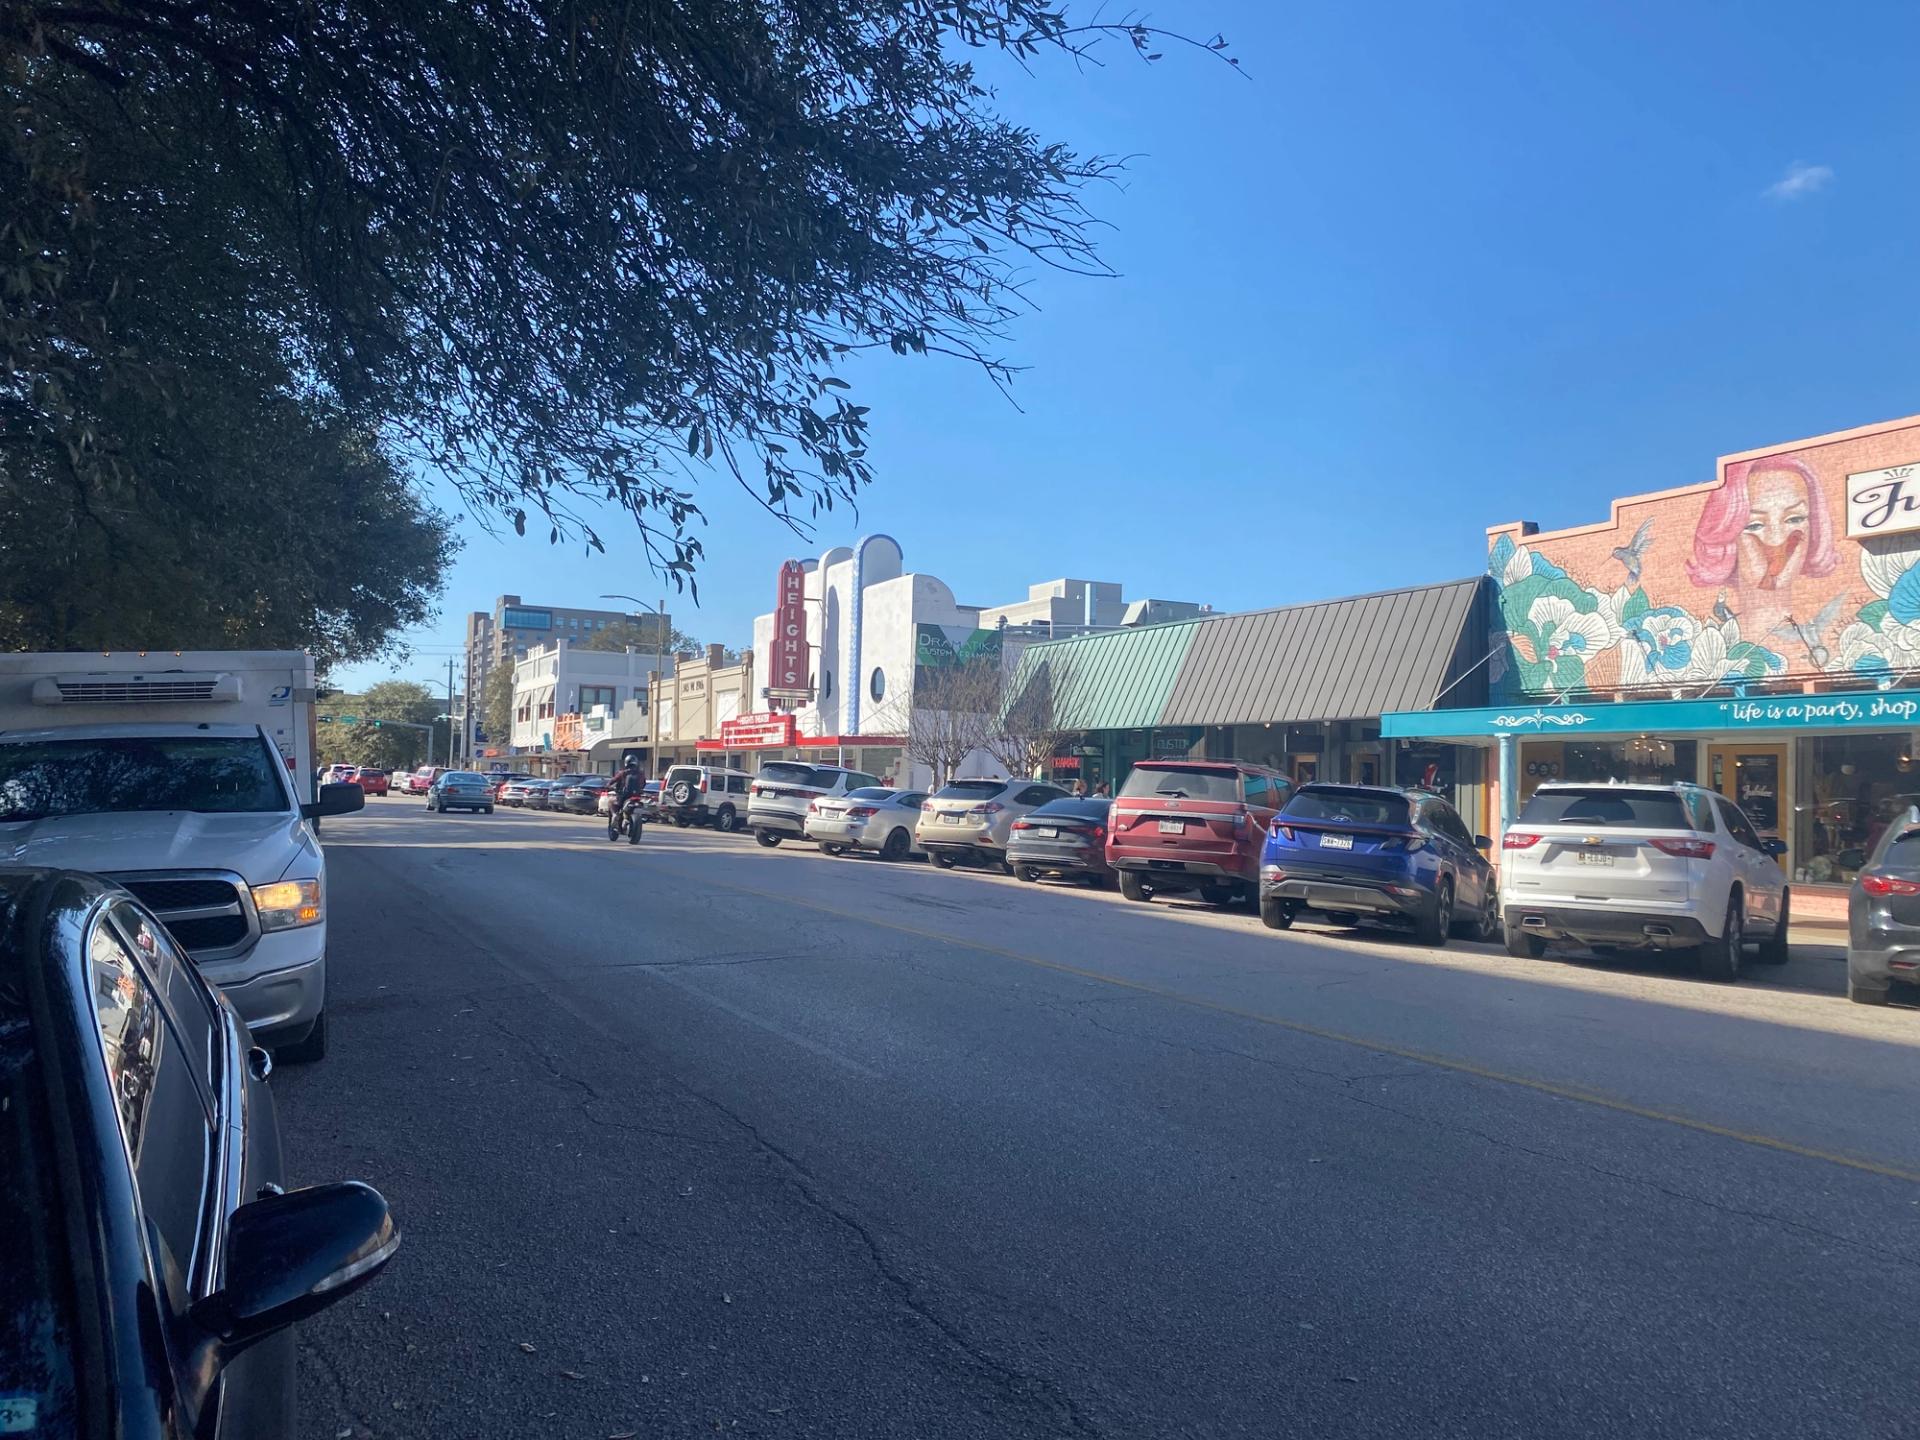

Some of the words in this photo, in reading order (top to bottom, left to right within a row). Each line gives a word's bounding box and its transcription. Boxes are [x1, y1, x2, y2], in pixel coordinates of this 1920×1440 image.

[783, 577, 800, 685] HEIGHTS
[918, 647, 953, 658] CUSTOM
[1767, 704, 1784, 720] is
[1786, 705, 1803, 718] a
[1804, 701, 1863, 722] party,
[1870, 697, 1918, 720] shop
